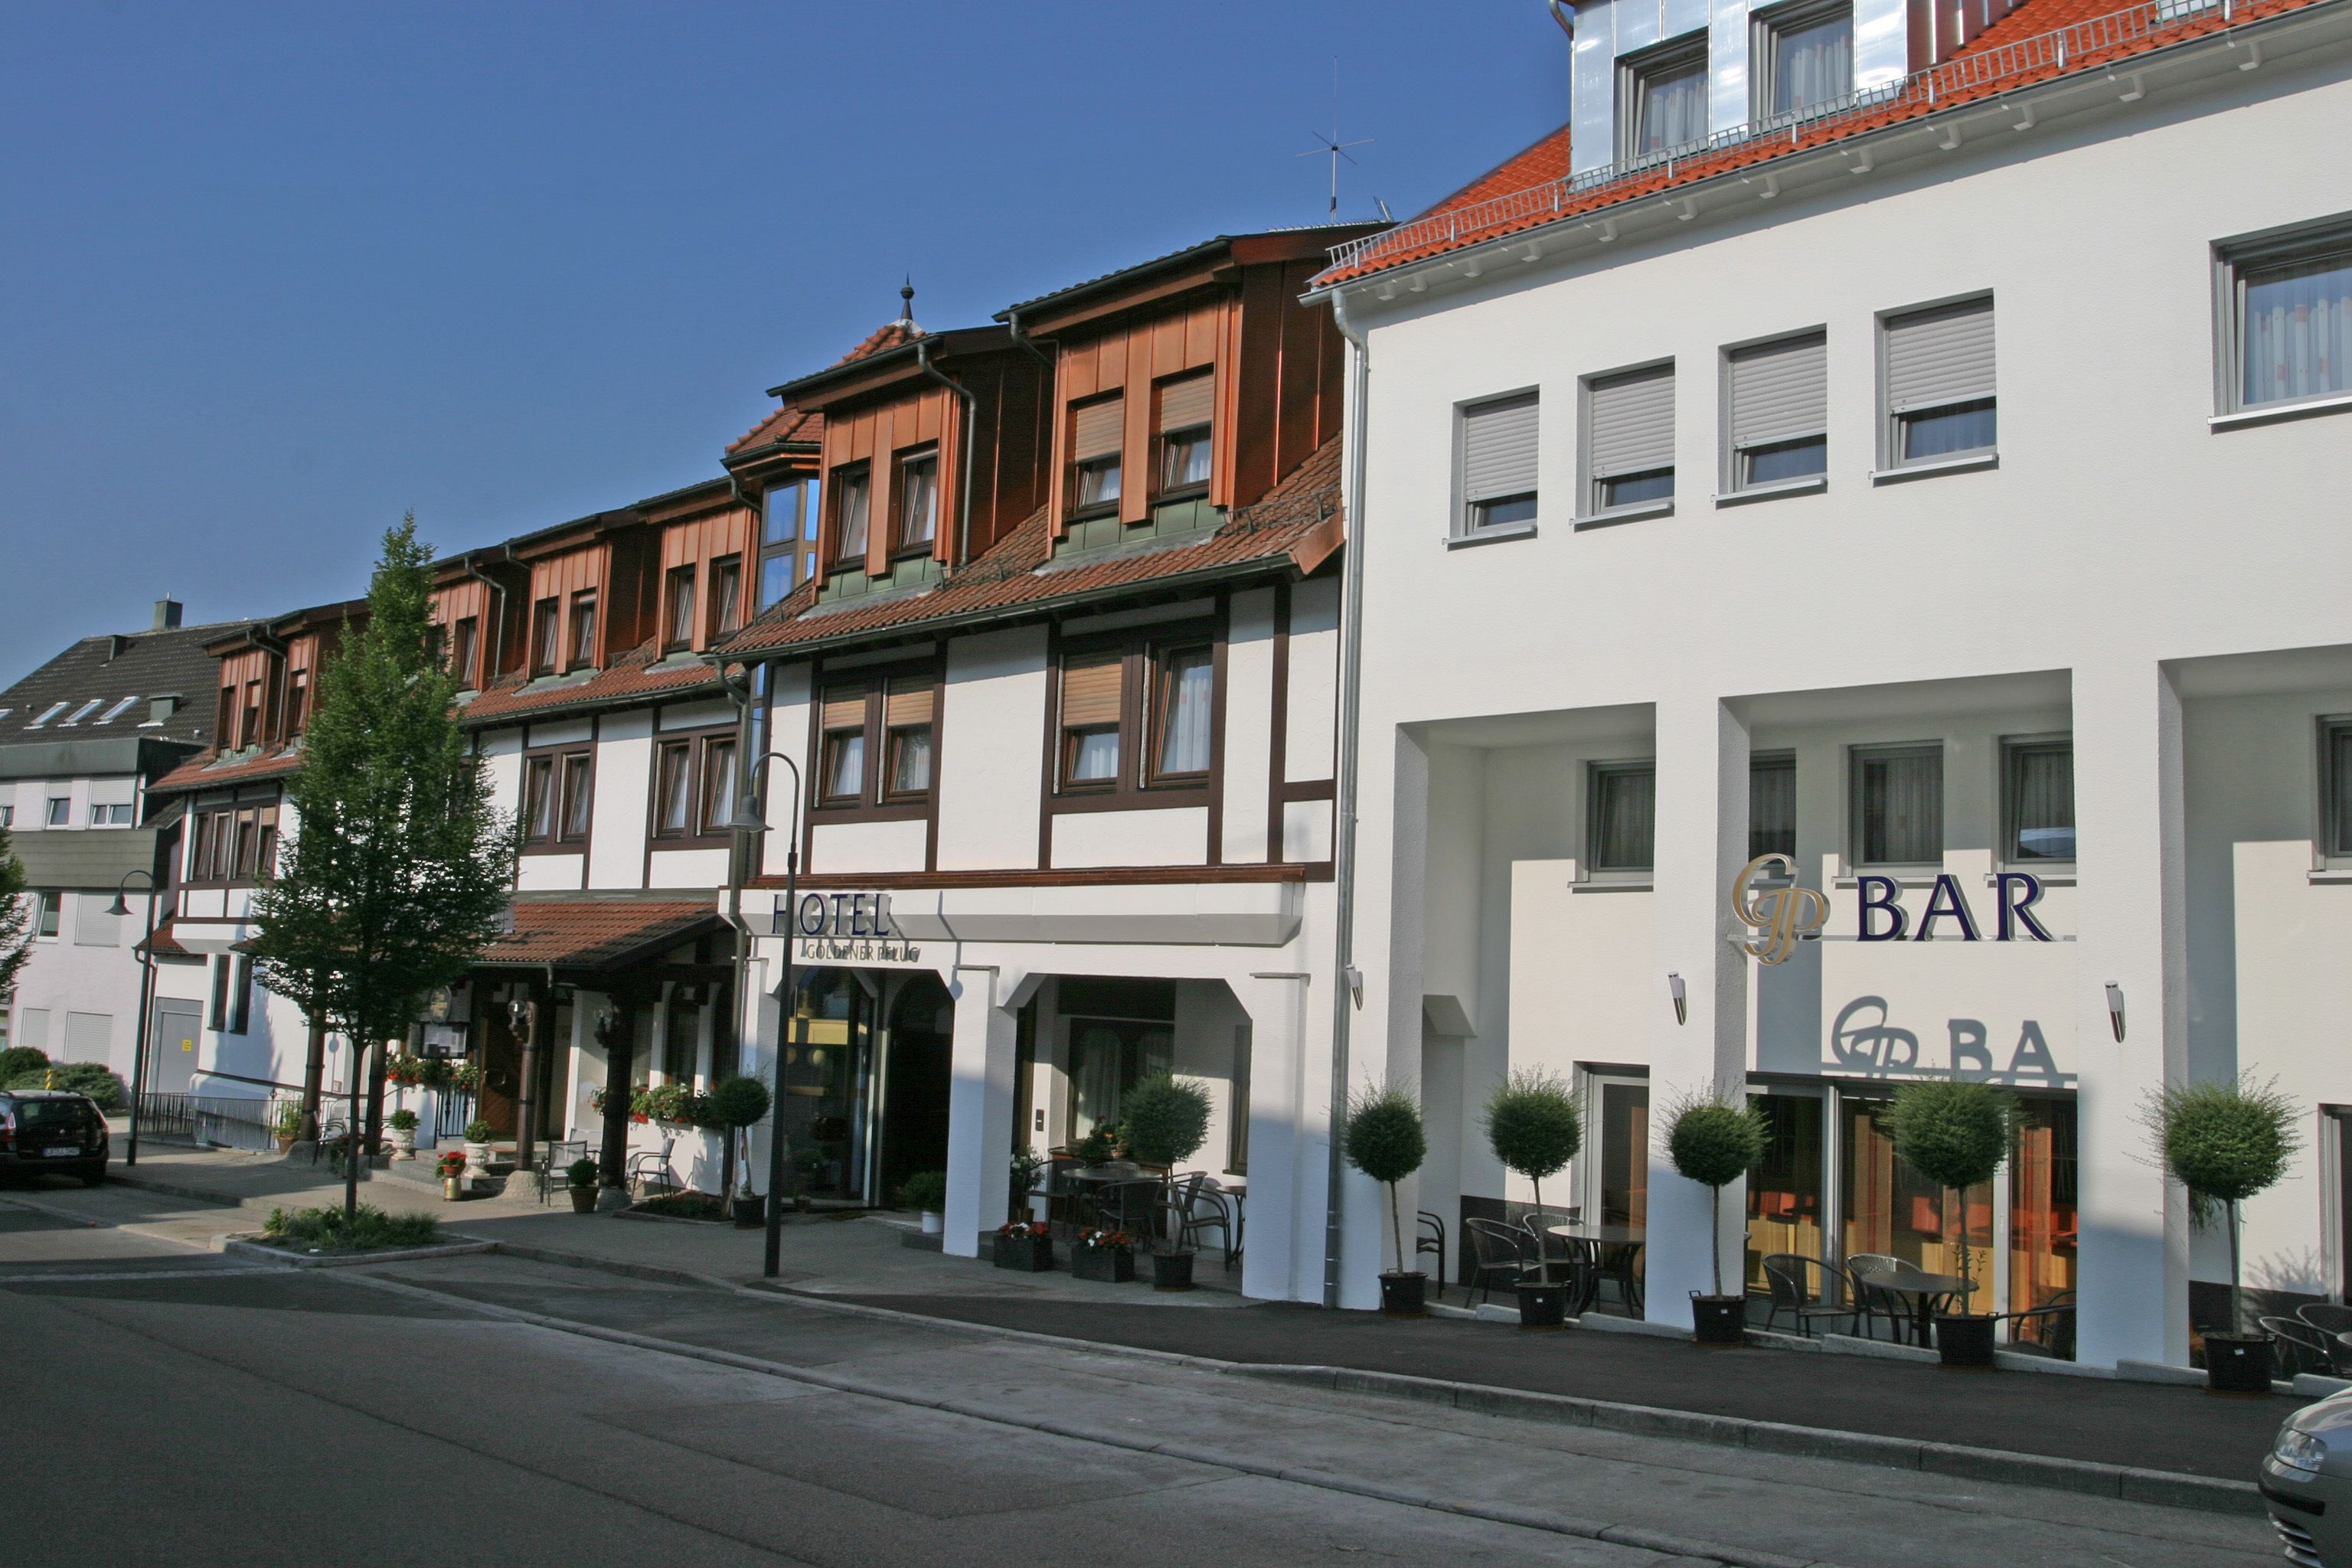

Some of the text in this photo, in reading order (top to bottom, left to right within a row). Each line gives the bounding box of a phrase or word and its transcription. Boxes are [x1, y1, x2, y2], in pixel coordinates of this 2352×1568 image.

[1857, 873, 2055, 942] BAR
[806, 943, 921, 963] GOLDENER PFLUG
